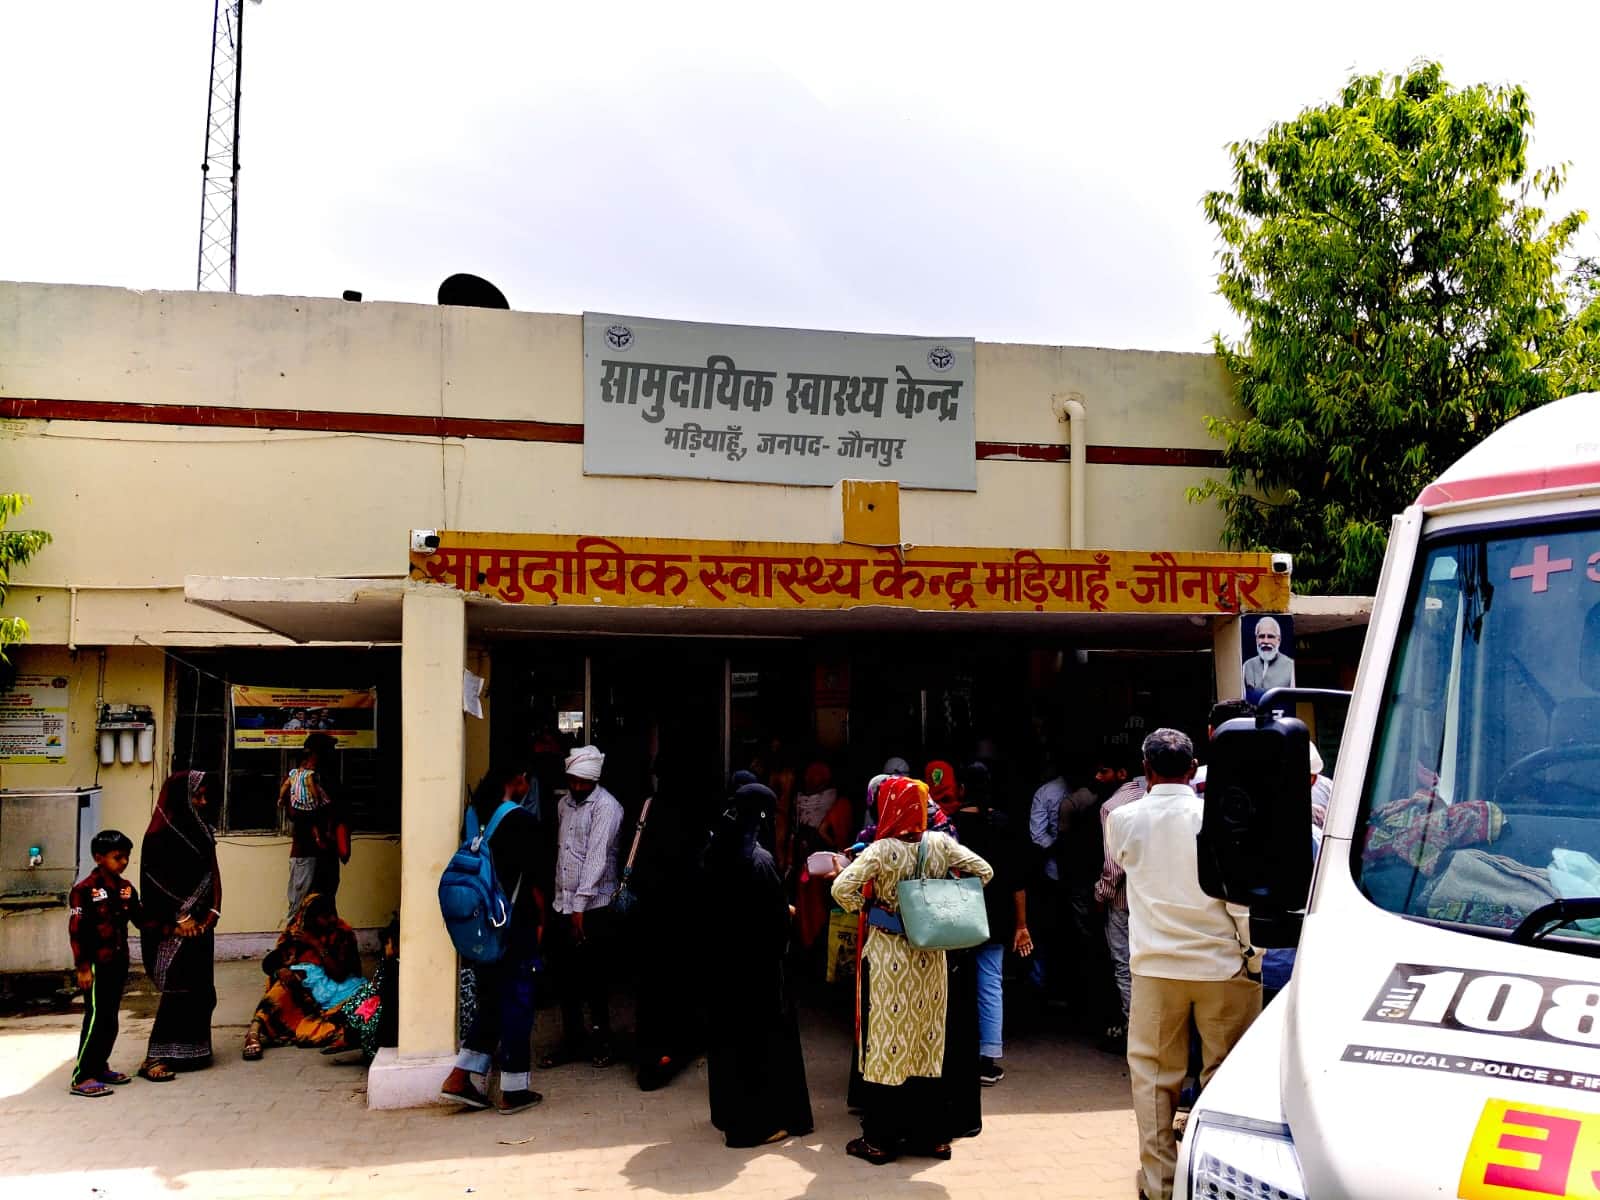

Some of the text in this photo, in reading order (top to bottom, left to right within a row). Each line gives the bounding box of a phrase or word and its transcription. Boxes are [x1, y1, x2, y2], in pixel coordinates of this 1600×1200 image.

[600, 355, 964, 424] सामुदायिक स्वास्थ्य केन्द्र
[837, 430, 907, 467] जौनपुर
[426, 537, 692, 601] सामुदायिक
[699, 555, 869, 604] स्वास्थ्य
[872, 546, 977, 609] केन्द्र
[1376, 988, 1418, 1018] CALL
[1407, 970, 1600, 1044] 108
[1364, 1050, 1451, 1069] MEDICAL
[1470, 1061, 1550, 1081] POLICE
